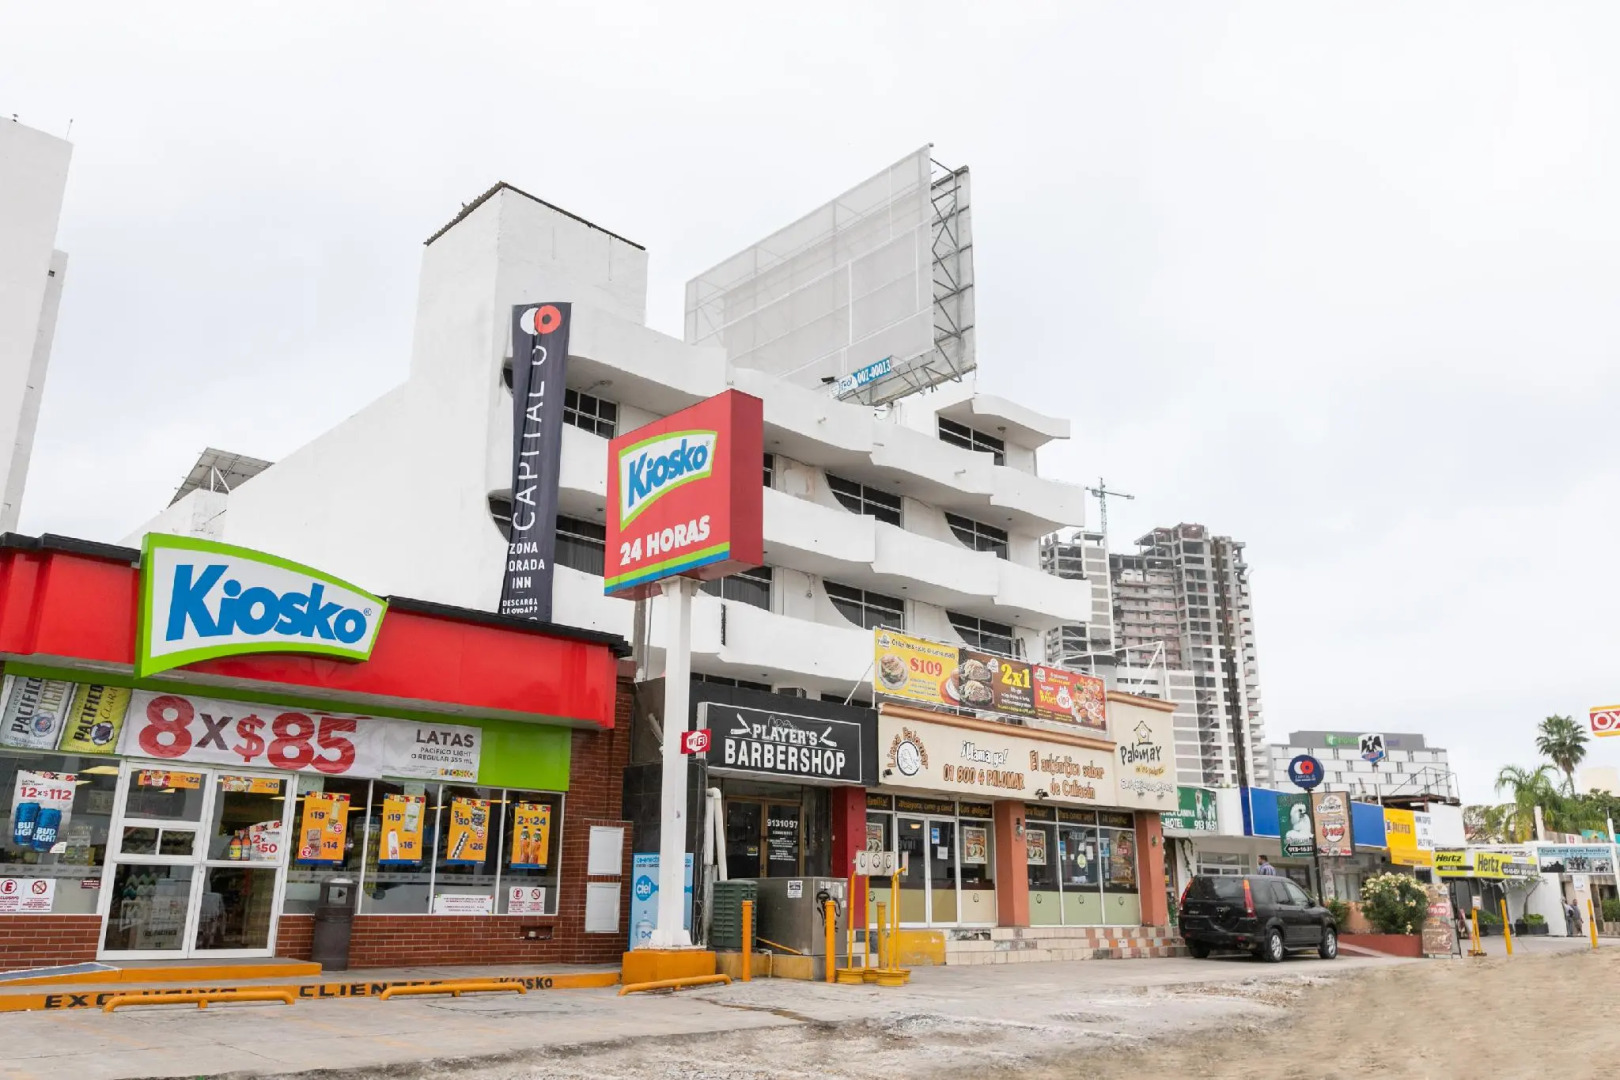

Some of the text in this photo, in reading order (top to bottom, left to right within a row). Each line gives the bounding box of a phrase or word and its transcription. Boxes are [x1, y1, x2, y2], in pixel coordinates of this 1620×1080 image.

[628, 439, 708, 508] Kiosko
[509, 542, 538, 555] ZONA
[620, 515, 710, 566] 24 HORAS
[508, 558, 545, 572] ORADA
[512, 576, 531, 589] INN
[165, 565, 367, 643] Kiosko
[502, 598, 538, 607] DESCARGA
[910, 658, 942, 676] $109
[1001, 664, 1031, 688] 2x1
[416, 729, 474, 748] LATAS
[752, 723, 817, 746] PLAYER'S
[417, 754, 449, 762] REGULAR
[725, 738, 846, 775] BARBERSHOP
[1029, 750, 1039, 771] El
[1082, 761, 1105, 780] sabor
[943, 764, 1026, 791] 01 800 4 PALOMAR
[1050, 778, 1061, 795] de
[36, 827, 56, 835] BUD
[767, 819, 798, 829] 9131097
[1165, 818, 1184, 828] HOTEL
[32, 833, 57, 842] LIGHT
[1436, 854, 1461, 862] Hertz
[1477, 854, 1499, 872] Hertz
[5, 882, 13, 891] E
[300, 979, 442, 998] CLIEN
